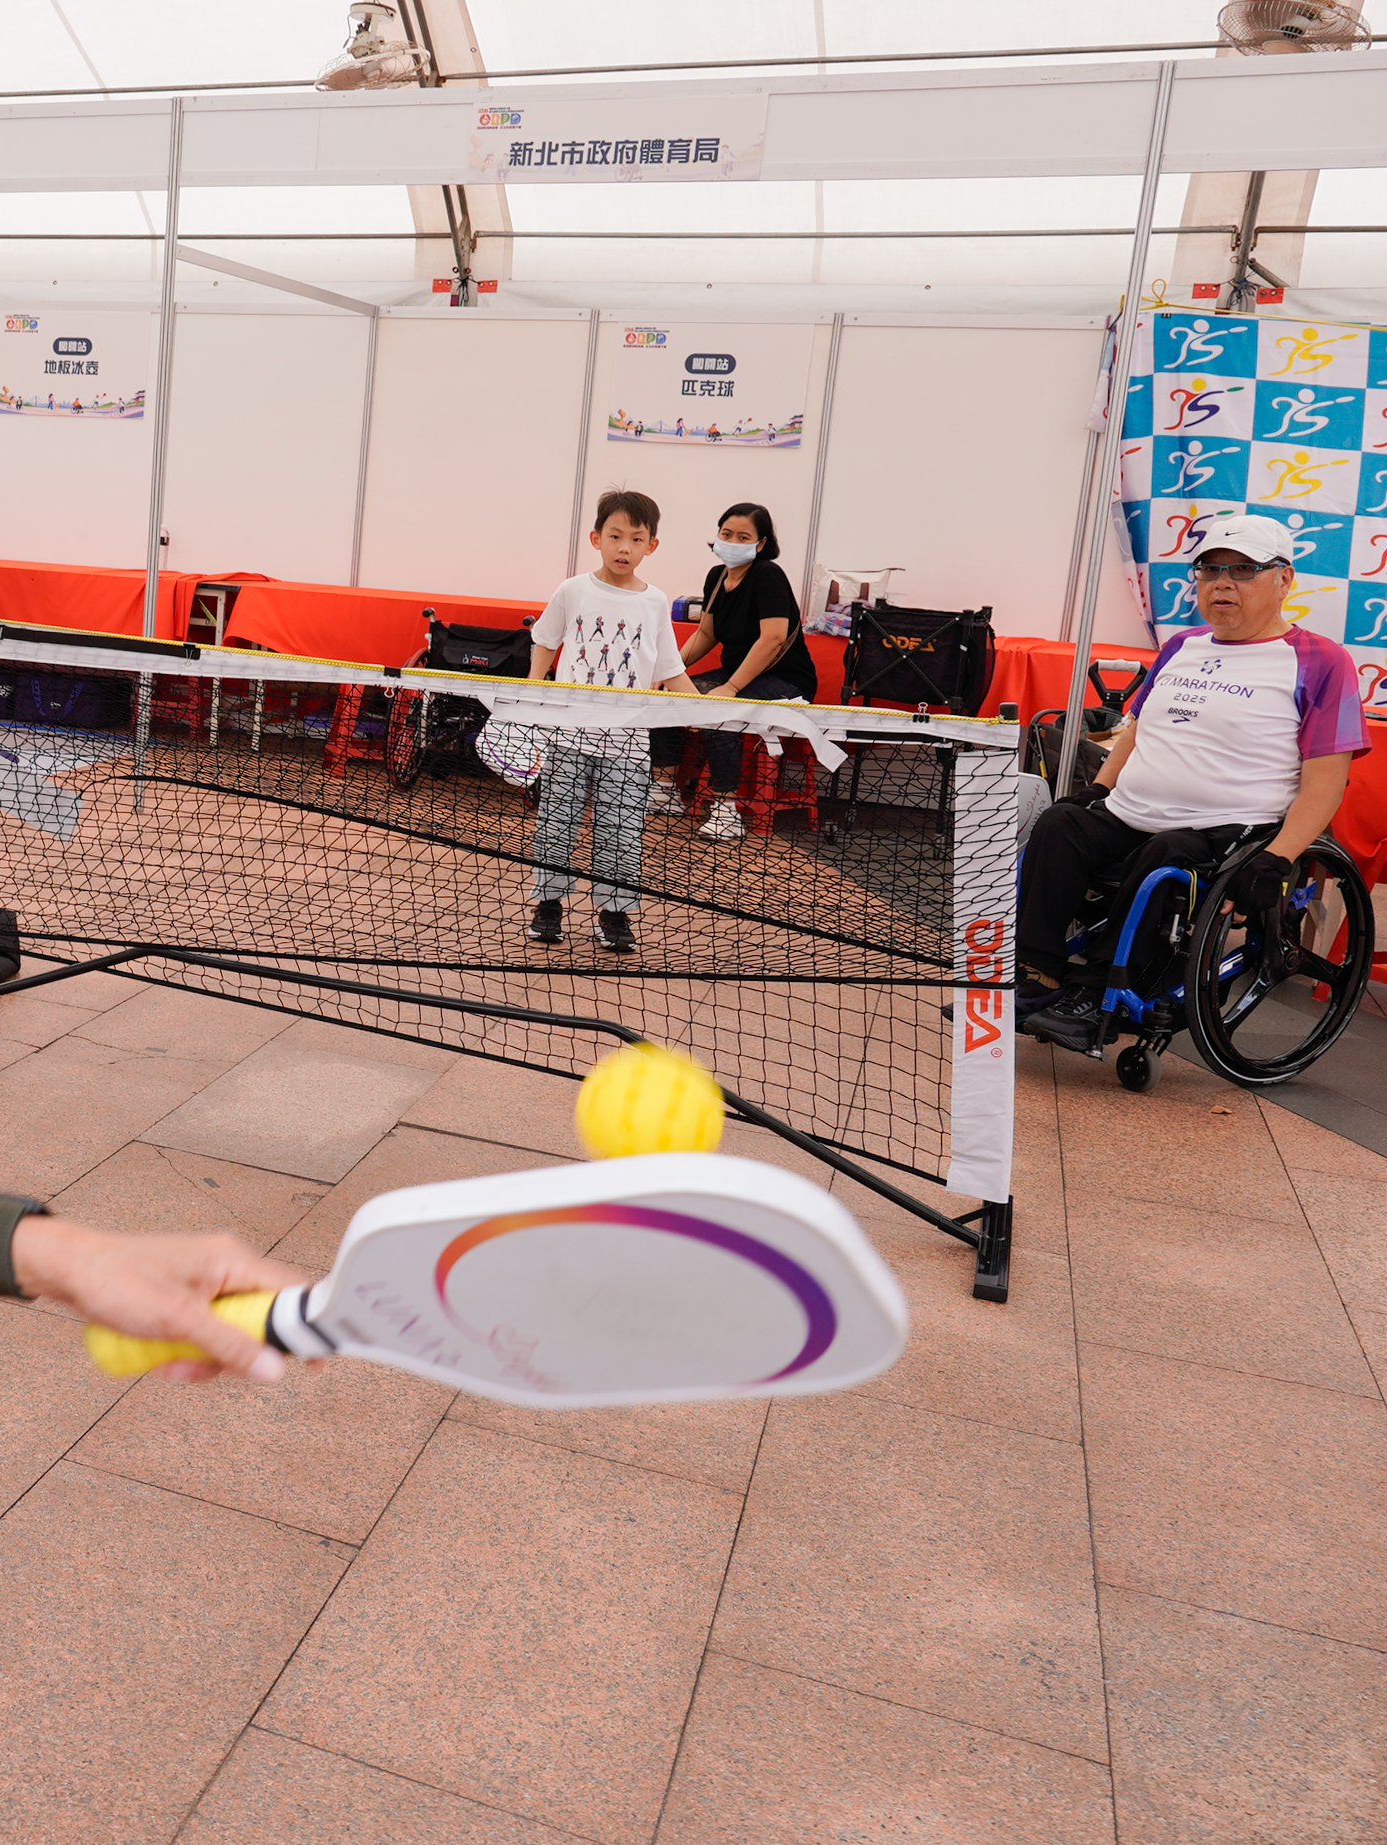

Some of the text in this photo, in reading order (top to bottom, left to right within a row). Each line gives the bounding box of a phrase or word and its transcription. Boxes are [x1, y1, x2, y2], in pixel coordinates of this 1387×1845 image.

[509, 138, 720, 166] 新北市政府體育局
[44, 360, 99, 375] 地板冰壺
[681, 379, 735, 397] 匹克球
[1170, 677, 1255, 699] MARATHON
[1173, 692, 1208, 704] 2025
[1167, 707, 1200, 718] BROOKS
[964, 919, 1005, 1054] ODEA
